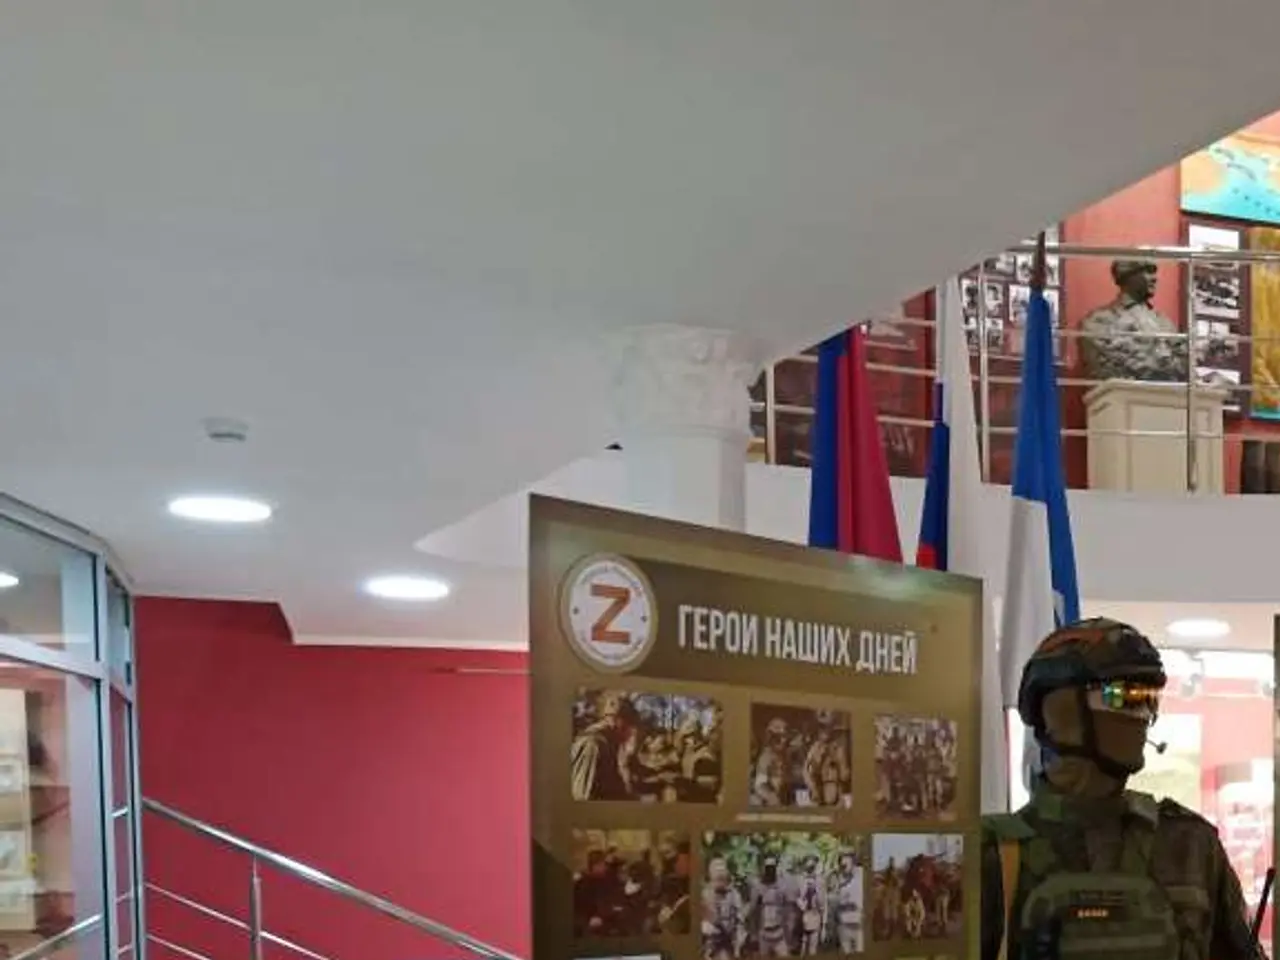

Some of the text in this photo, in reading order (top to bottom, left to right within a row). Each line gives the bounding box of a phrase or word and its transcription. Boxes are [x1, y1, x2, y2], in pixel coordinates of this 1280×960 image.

[591, 583, 631, 645] Z
[677, 603, 758, 655] ГЕРОИ
[764, 617, 850, 667] НАШИХ
[855, 629, 918, 674] ДНЕЙ
